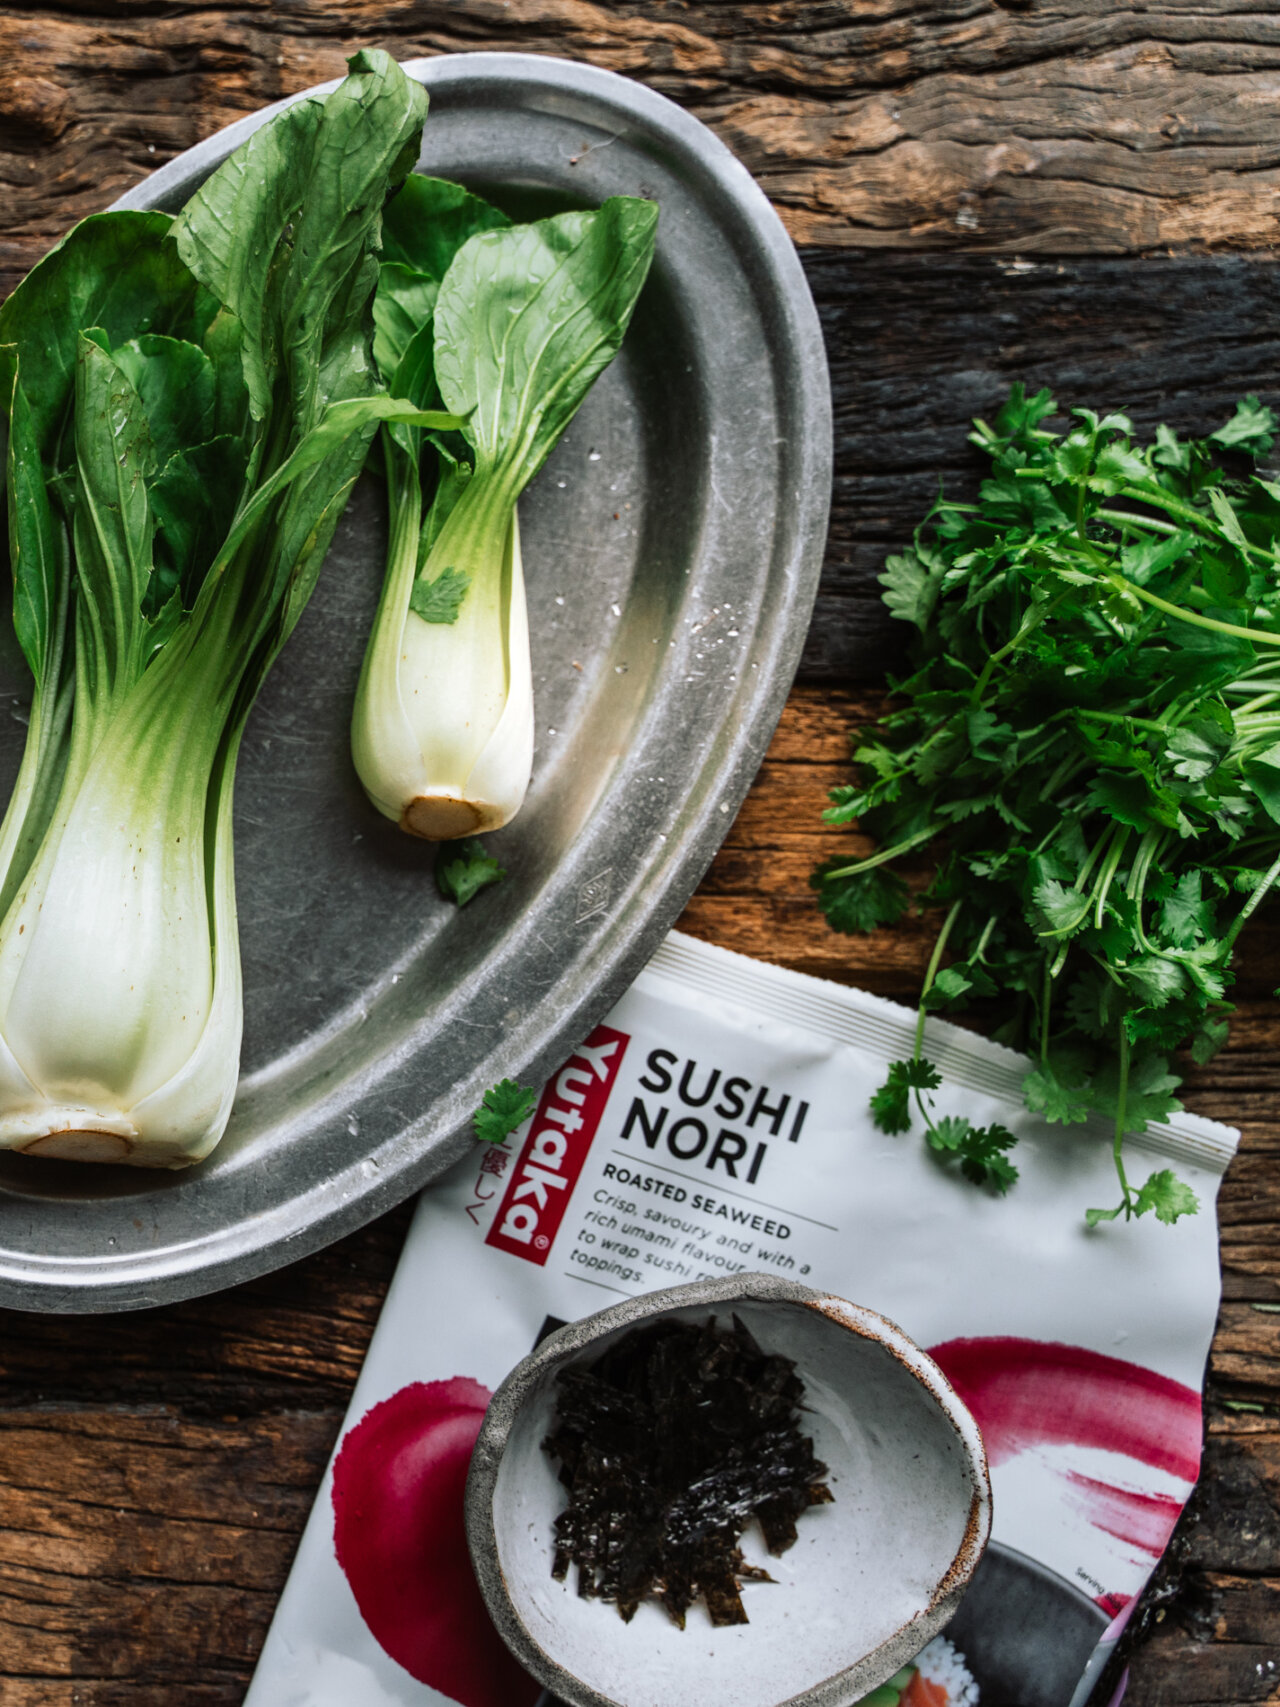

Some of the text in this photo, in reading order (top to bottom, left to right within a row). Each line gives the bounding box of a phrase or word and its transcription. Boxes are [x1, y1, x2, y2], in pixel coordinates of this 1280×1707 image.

[638, 1048, 809, 1143] SUSHI
[619, 1096, 767, 1184] NORI
[584, 1211, 617, 1228] rich
[621, 1223, 676, 1248] umami
[593, 1188, 810, 1274] Crisp, savoury and with a
[602, 1162, 790, 1239] ROASTED SEAWEED
[569, 1248, 643, 1282] toppings.
[577, 1229, 596, 1244] to
[601, 1241, 639, 1258] wrap
[643, 1253, 690, 1276] sushi
